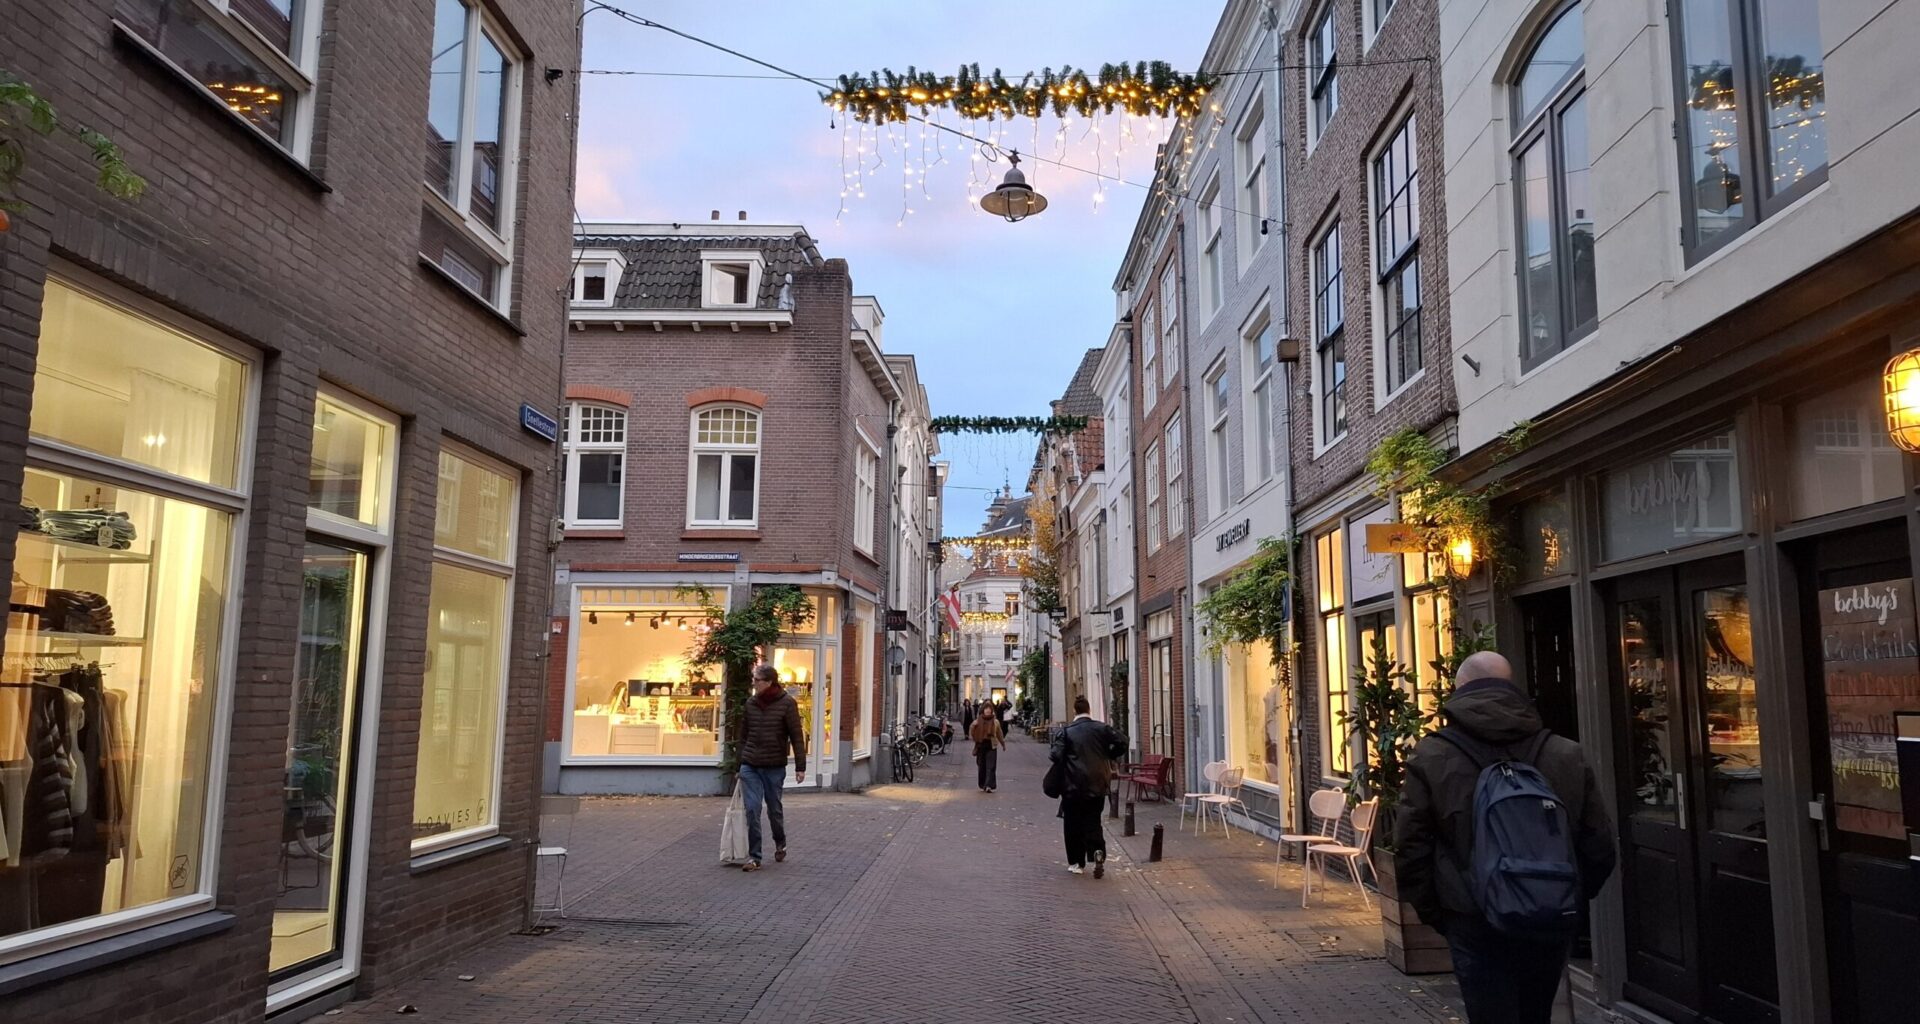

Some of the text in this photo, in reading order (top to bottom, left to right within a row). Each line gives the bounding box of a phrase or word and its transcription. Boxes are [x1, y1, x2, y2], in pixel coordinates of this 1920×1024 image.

[1834, 586, 1898, 625] bobby's
[1824, 627, 1918, 662] Cocktails
[418, 808, 471, 832] LOAVIES
